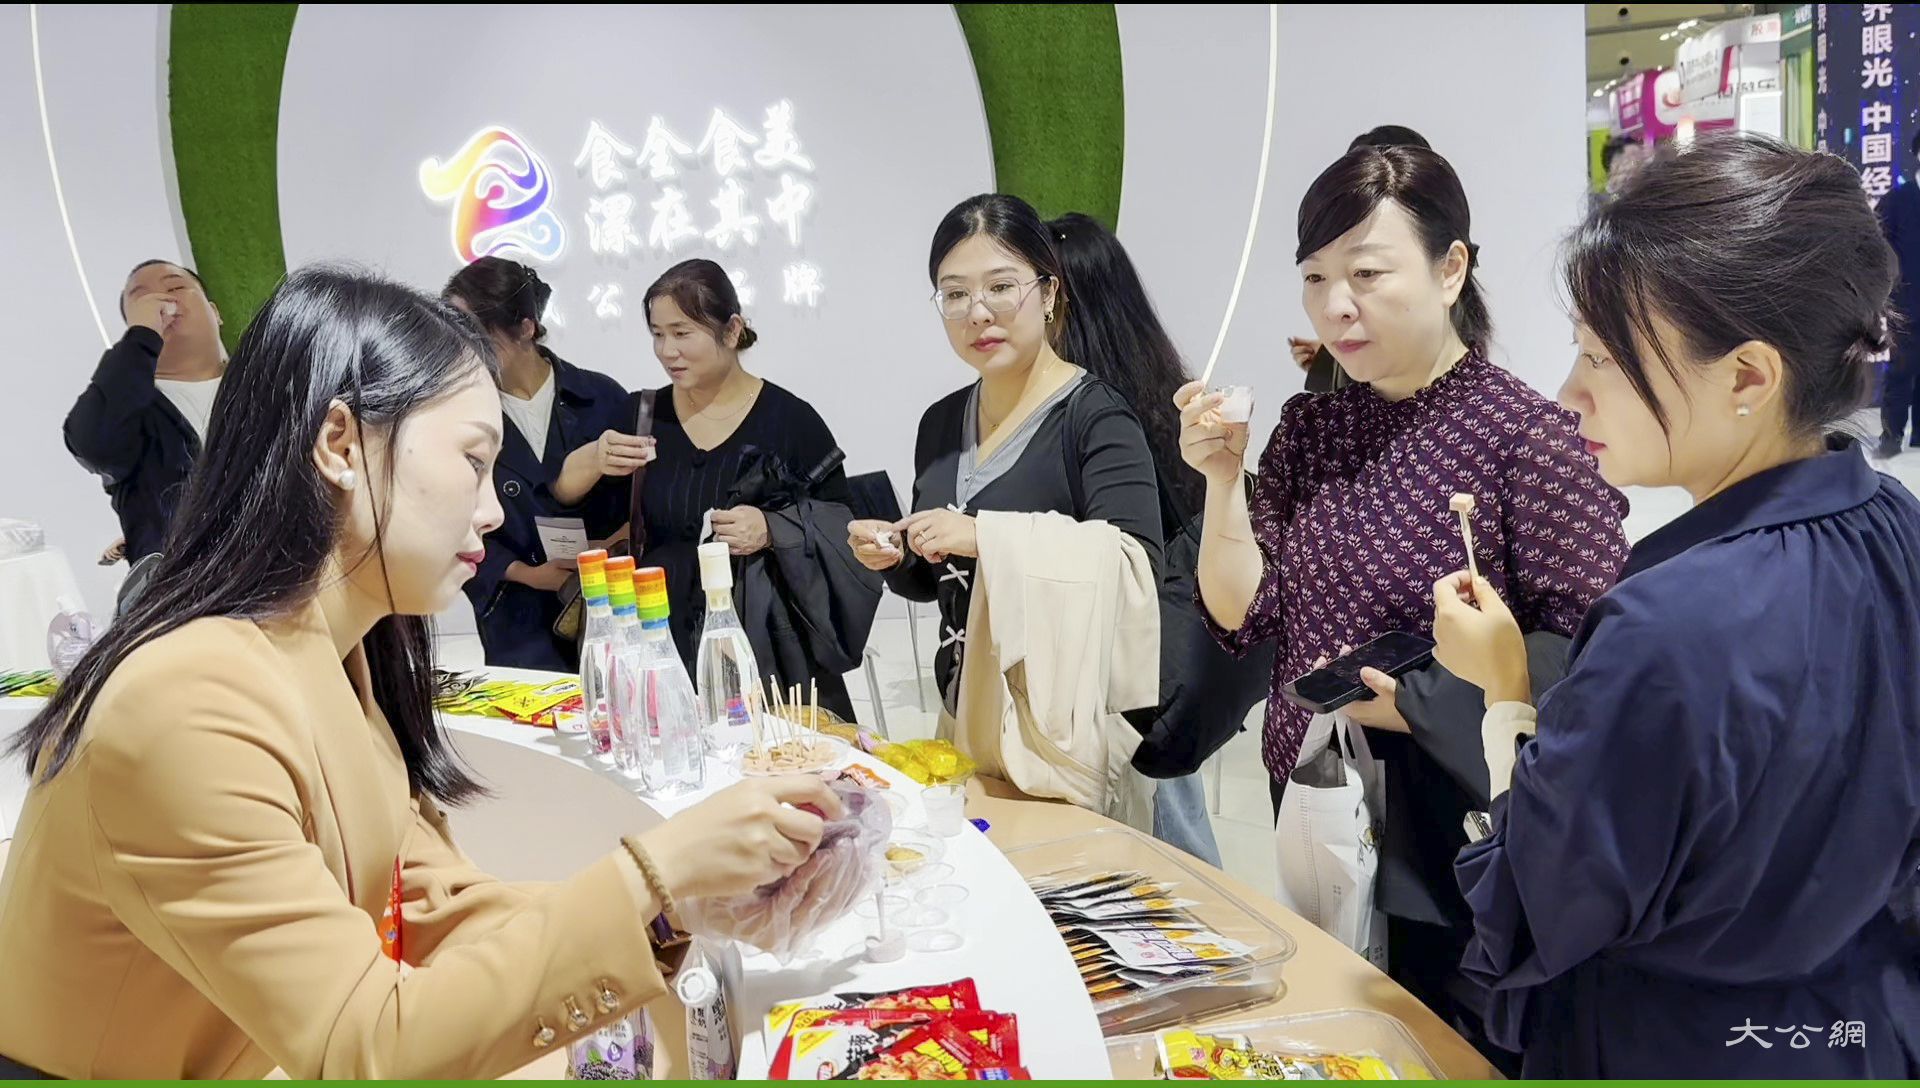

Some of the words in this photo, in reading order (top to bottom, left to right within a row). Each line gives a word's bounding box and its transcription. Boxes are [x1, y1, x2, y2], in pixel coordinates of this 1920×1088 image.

[575, 99, 814, 188] 食全食美
[1861, 101, 1892, 212] 中国经
